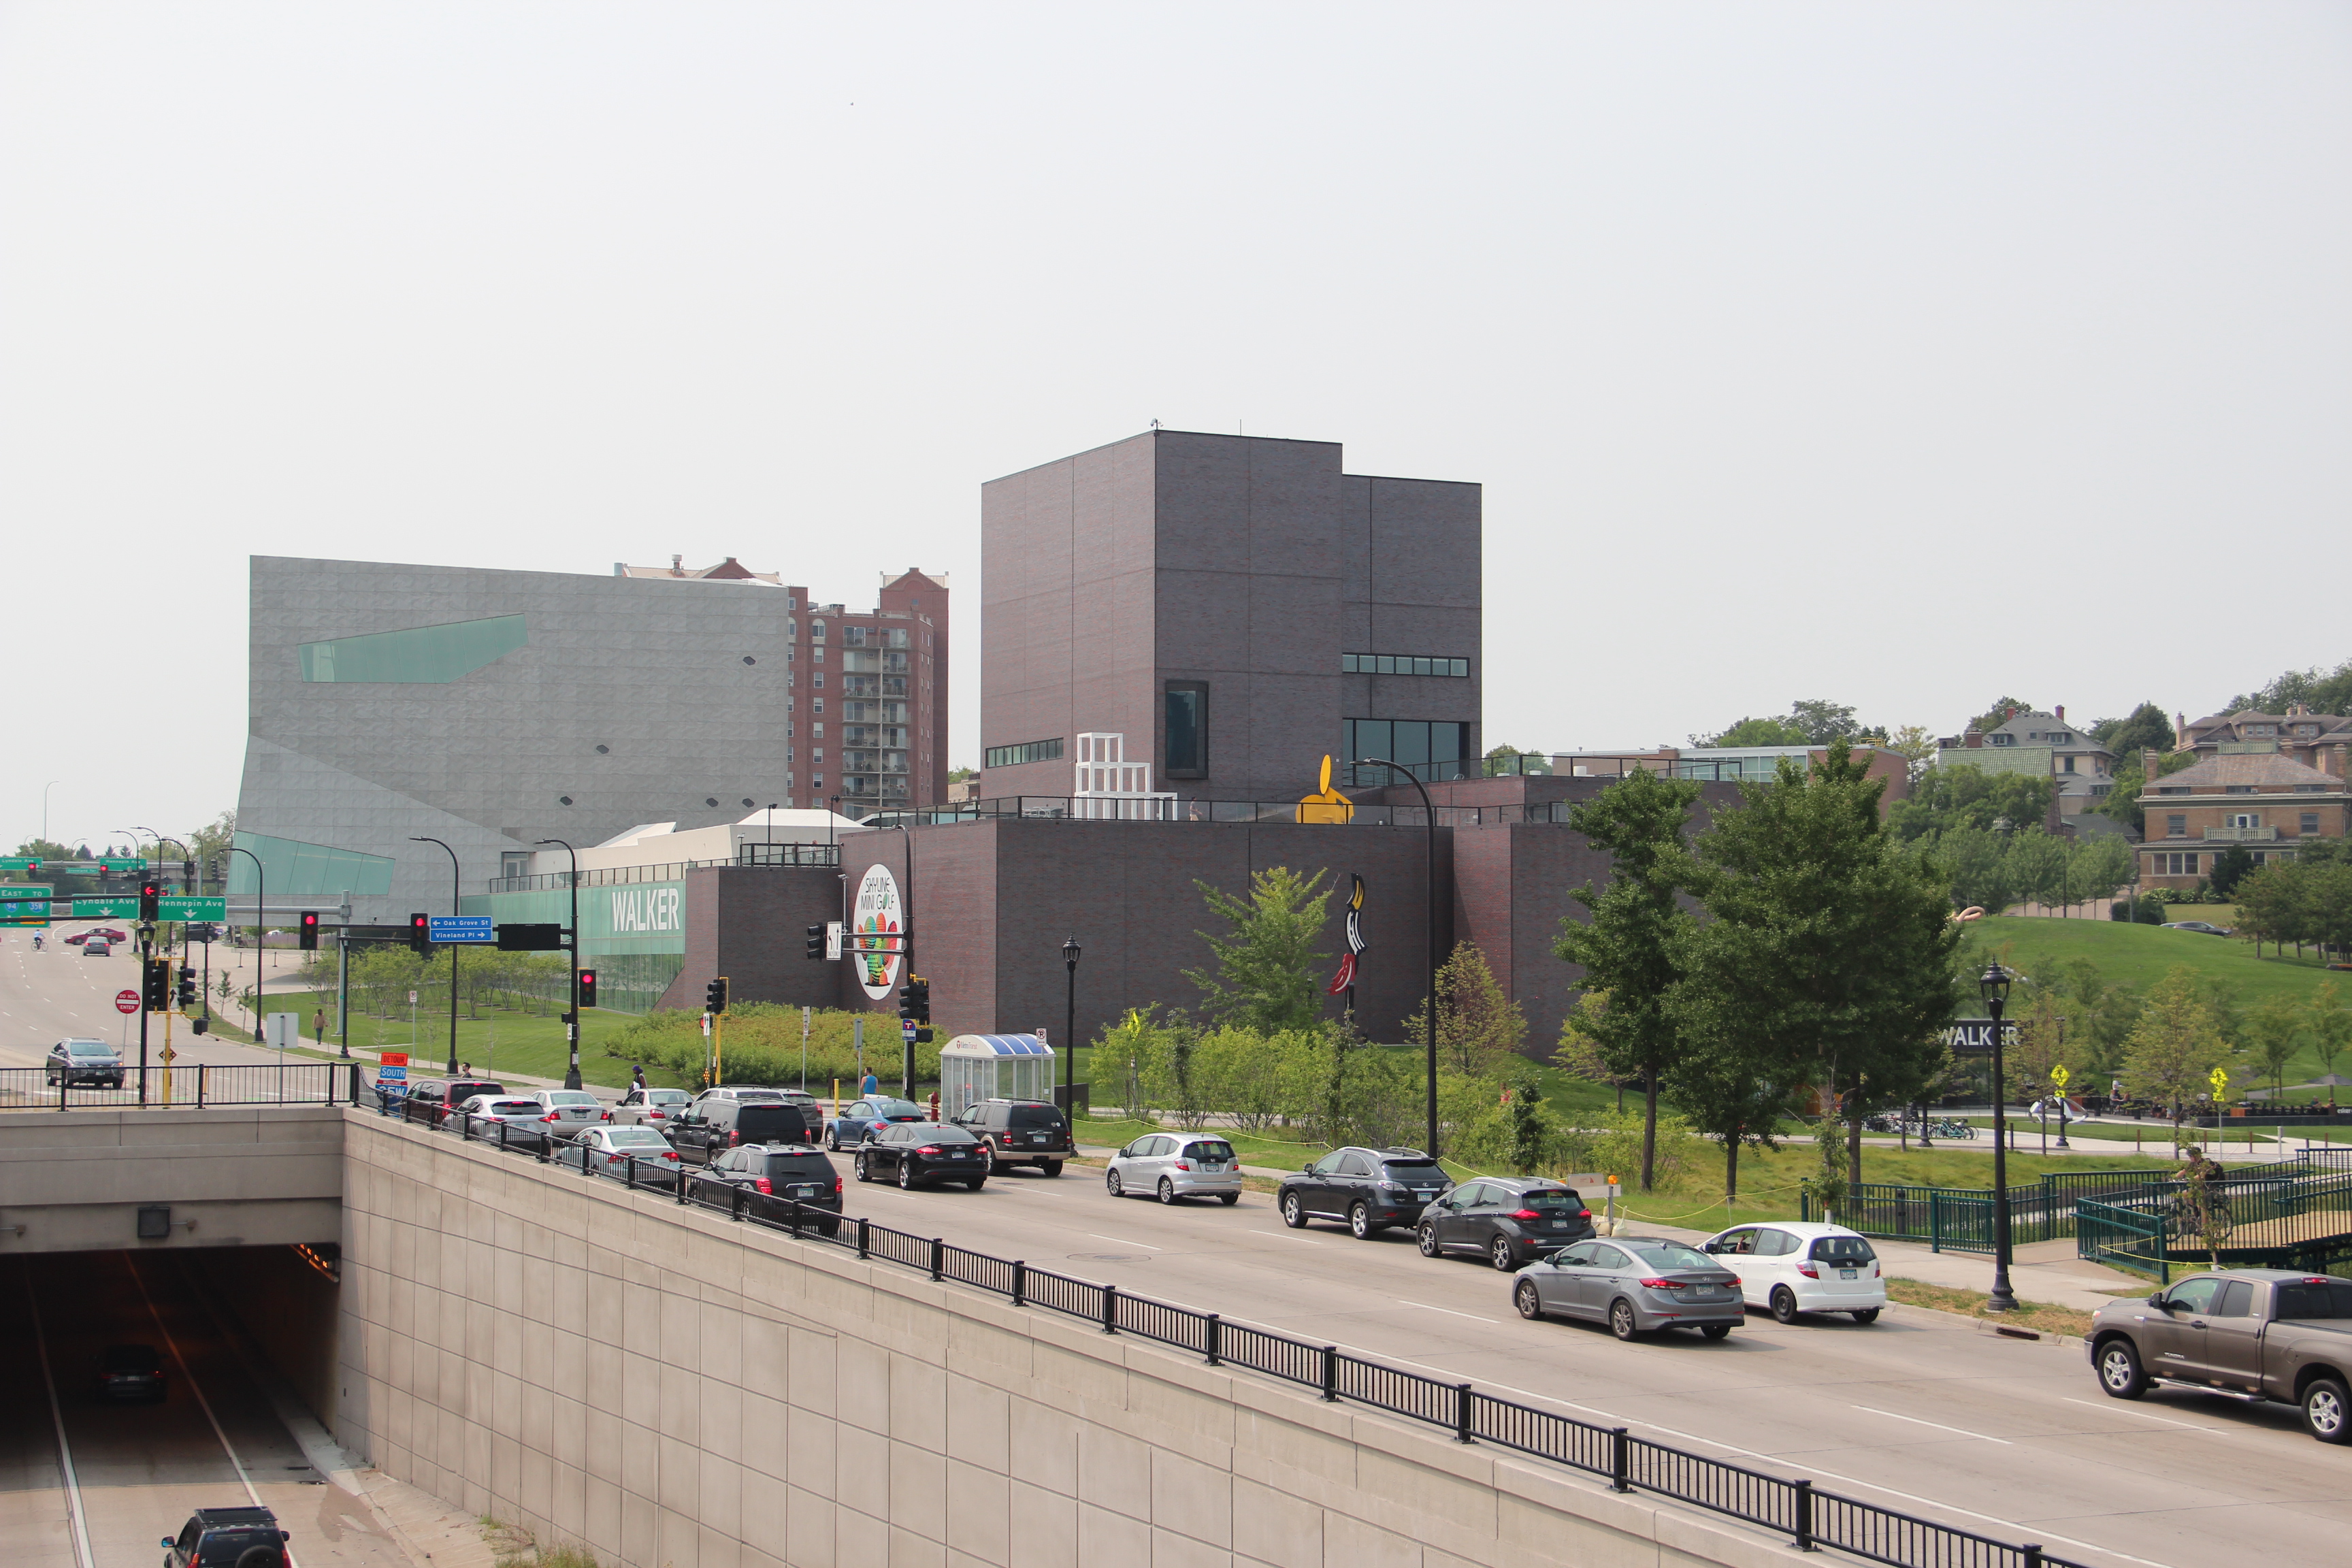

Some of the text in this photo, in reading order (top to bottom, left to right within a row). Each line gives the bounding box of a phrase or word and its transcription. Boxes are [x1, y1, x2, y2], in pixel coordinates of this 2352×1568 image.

[866, 877, 889, 893] SKYLINE
[159, 900, 201, 908] Hennepin
[861, 893, 894, 910] MINI GOLF
[612, 888, 680, 932] WALKER
[381, 1067, 406, 1077] SOUTH
[2164, 1352, 2185, 1360] TUNDRA
